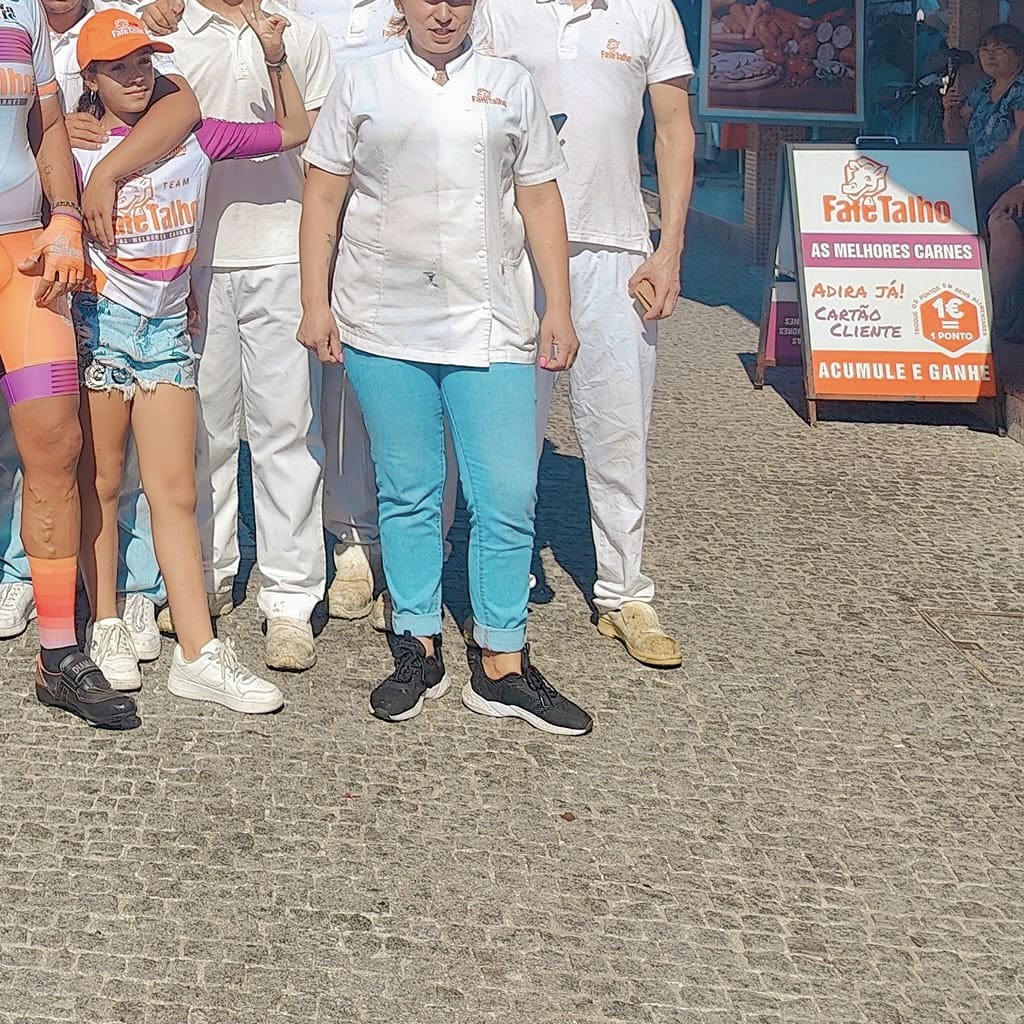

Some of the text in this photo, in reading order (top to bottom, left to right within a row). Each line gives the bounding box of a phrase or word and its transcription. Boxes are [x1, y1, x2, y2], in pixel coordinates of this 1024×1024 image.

[163, 178, 190, 190] TEAM
[822, 195, 951, 224] FafeTalho
[811, 242, 973, 260] AS MELHORES CARNES
[814, 304, 882, 321] CARTÃO
[932, 297, 965, 319] 1€
[830, 323, 902, 338] CLIENTE
[938, 331, 973, 341] PONTO
[818, 361, 992, 382] ACUMULE E GANHE
